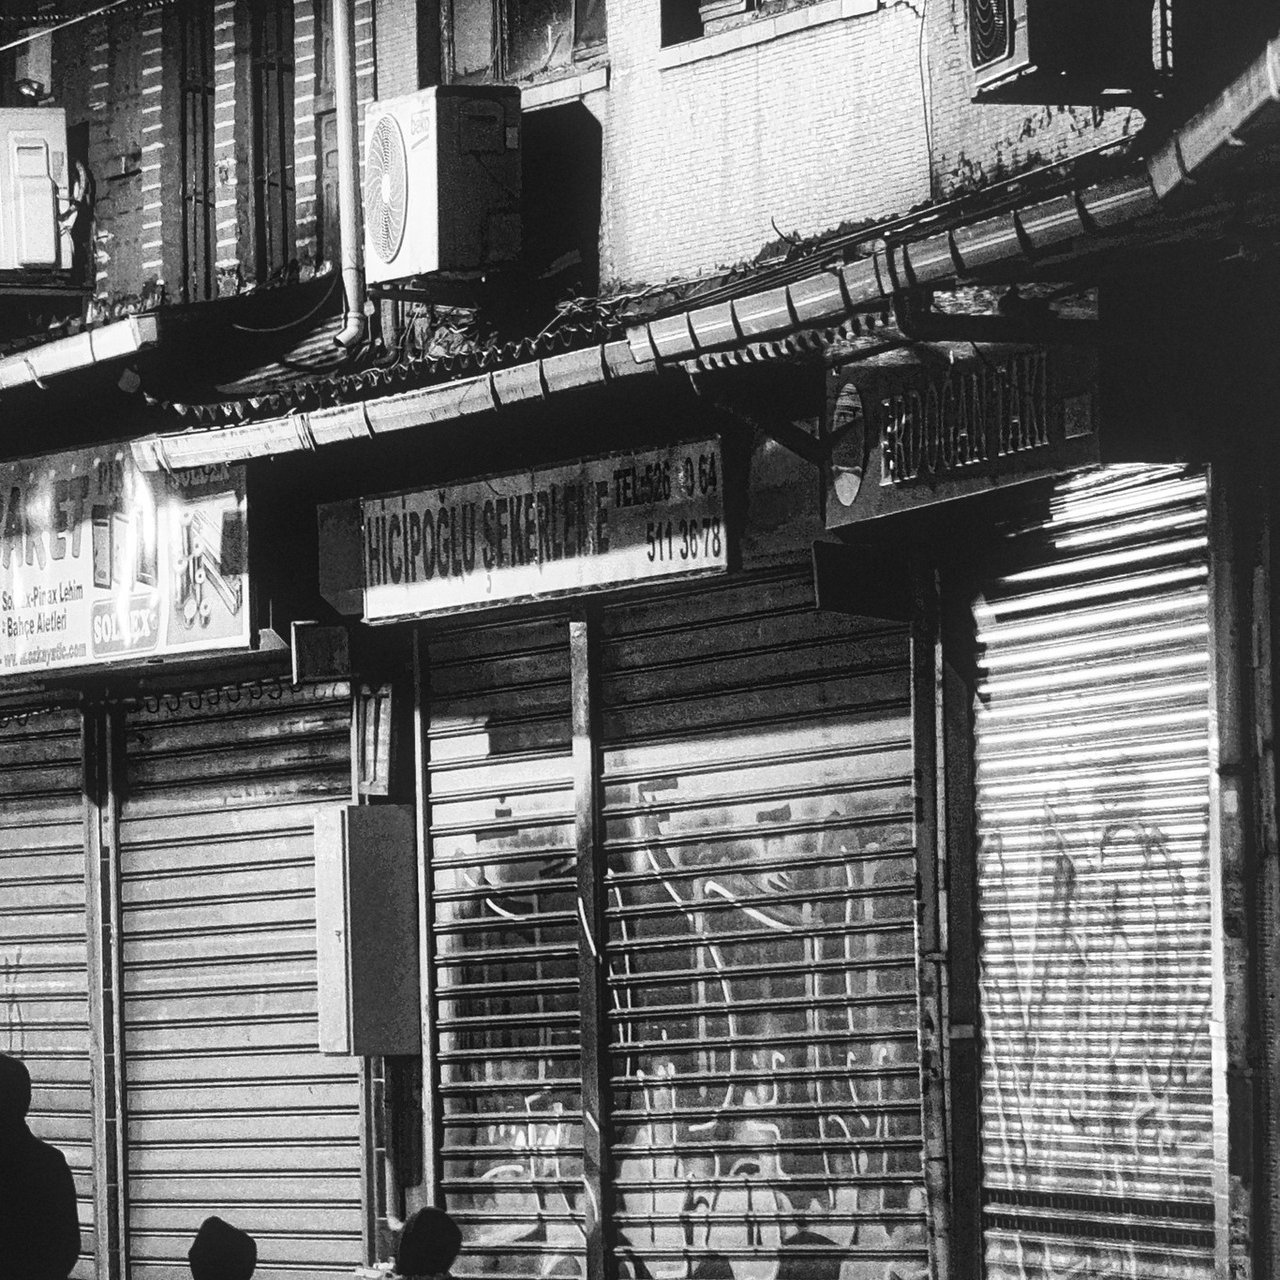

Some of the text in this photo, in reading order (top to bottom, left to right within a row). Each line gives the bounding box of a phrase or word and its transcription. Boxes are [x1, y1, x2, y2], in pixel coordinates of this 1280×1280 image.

[646, 516, 722, 562] 511 36 78
[59, 579, 84, 603] Lehim
[6, 615, 35, 640] Bahçe
[36, 607, 67, 635] Aletleri
